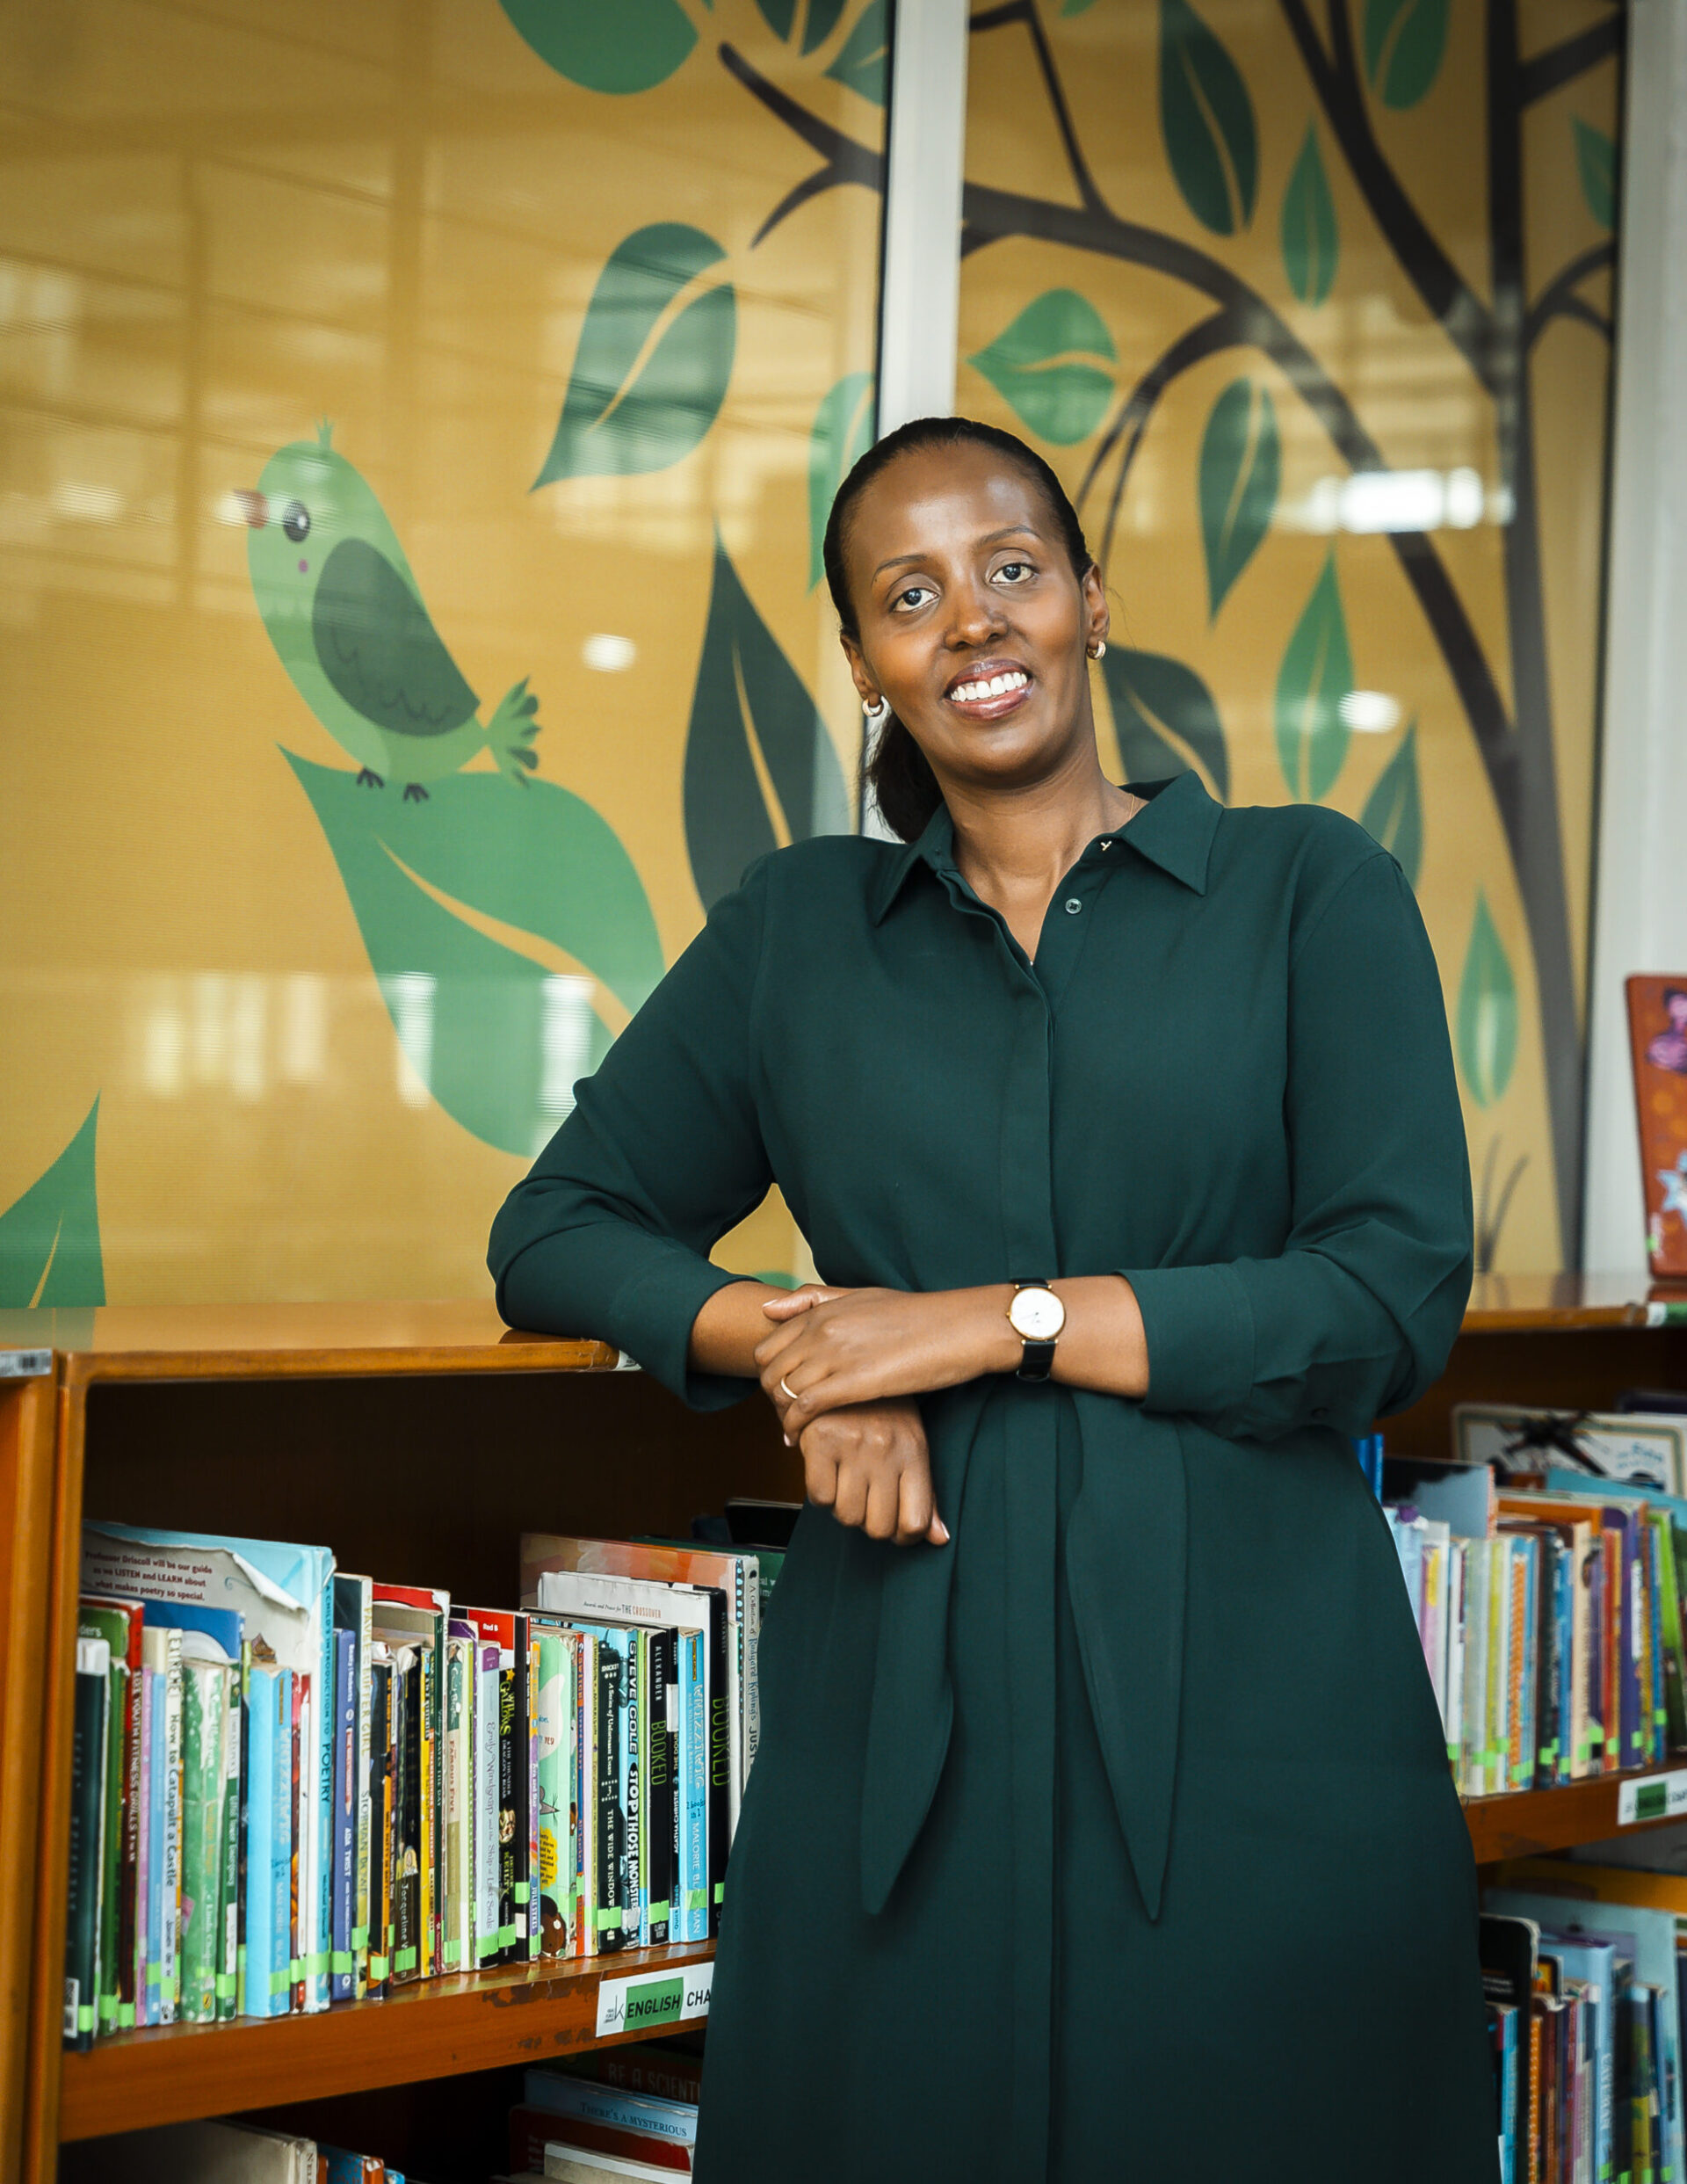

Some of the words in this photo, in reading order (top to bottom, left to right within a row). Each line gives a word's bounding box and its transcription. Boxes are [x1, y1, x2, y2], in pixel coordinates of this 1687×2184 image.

[115, 1569, 141, 1578] LISTEN
[142, 1572, 156, 1581] and
[157, 1573, 183, 1583] LEARN
[185, 1578, 206, 1587] about
[122, 1554, 151, 1566] Driscoll
[153, 1558, 165, 1567] will
[192, 1564, 213, 1574] guide
[115, 1583, 138, 1593] makes
[140, 1585, 165, 1598] poetry
[177, 1590, 206, 1601] special.
[622, 1604, 632, 1614] THE
[628, 1642, 637, 1699] STEVE
[749, 1637, 758, 1677] Rudyard
[131, 1696, 141, 1737] YOUTH
[748, 1681, 758, 1721] Kipling's
[169, 1715, 181, 1745] How
[323, 1722, 330, 1735] TO
[361, 1723, 371, 1757] GIRL
[484, 1721, 496, 1753] Emily
[628, 1706, 637, 1754] COLE
[713, 1696, 730, 1786] BOOKED
[749, 1726, 757, 1760] JUST
[130, 1738, 141, 1789] FITNESS
[169, 1750, 179, 1764] to
[650, 1720, 667, 1785] BOOKED
[321, 1743, 331, 1803] POETRY
[484, 1754, 496, 1815] Windsnap
[628, 1770, 639, 1813] STOP
[128, 1790, 140, 1832] DRILLS
[166, 1768, 179, 1827] Catapult
[167, 1832, 175, 1840] a
[486, 1845, 496, 1866] Ship
[627, 1814, 638, 1857] THOSE
[691, 1823, 700, 1869] MALORIE
[166, 1845, 177, 1887] Castle
[400, 1883, 409, 1941] Jacqueline
[486, 1900, 495, 1929] Souls
[626, 1993, 681, 2019] ENGLISH
[686, 1988, 711, 2006] CHA
[648, 2072, 700, 2103] SCIENTI
[580, 2101, 619, 2121] THERE'S
[620, 2113, 627, 2123] A
[629, 2115, 687, 2137] MYSTERIOUS
